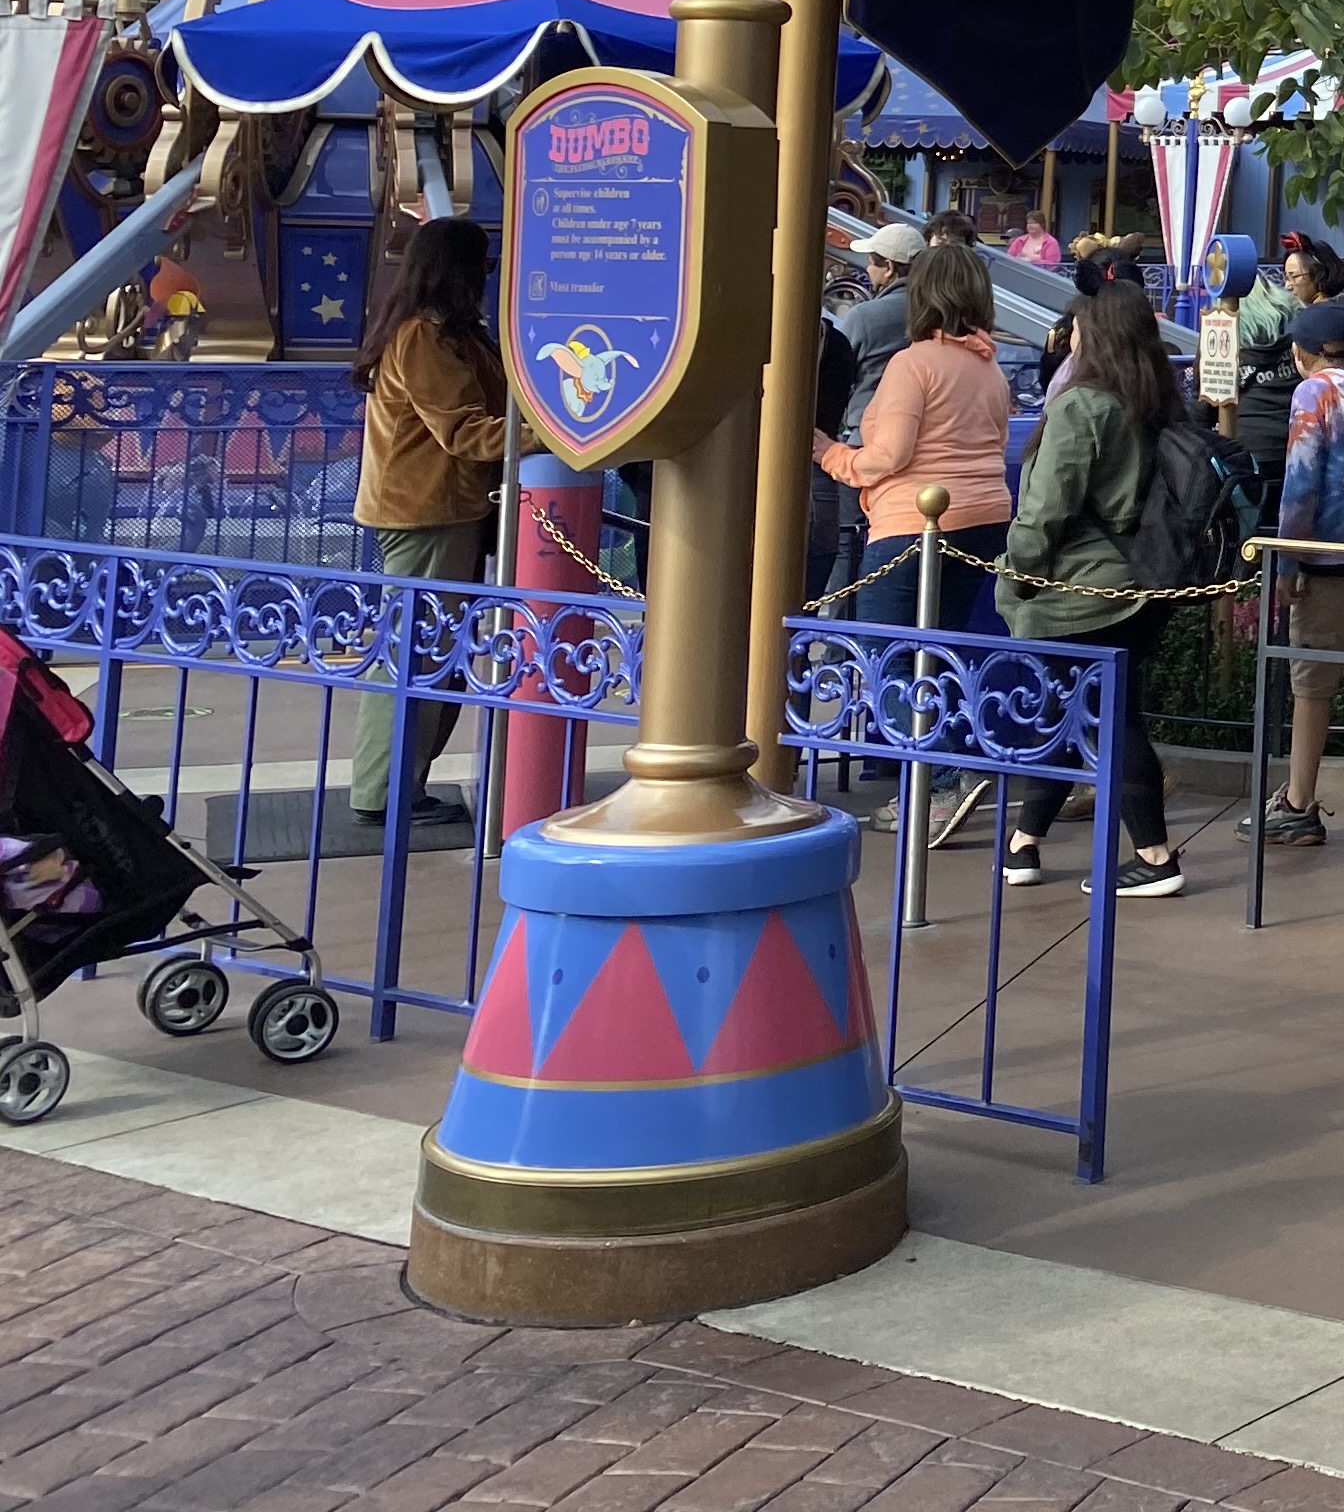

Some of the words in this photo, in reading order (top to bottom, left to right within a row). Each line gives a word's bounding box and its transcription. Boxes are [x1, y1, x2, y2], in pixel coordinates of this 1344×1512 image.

[548, 118, 650, 163] DUMBO
[594, 188, 630, 199] children
[552, 217, 585, 228] Children
[613, 221, 629, 232] age
[637, 221, 662, 232] years
[582, 234, 637, 247] accompanied
[640, 234, 650, 247] by
[652, 236, 659, 245] a
[604, 251, 627, 262] years
[629, 252, 640, 260] or
[641, 249, 667, 260] older.
[570, 282, 605, 293] transfer
